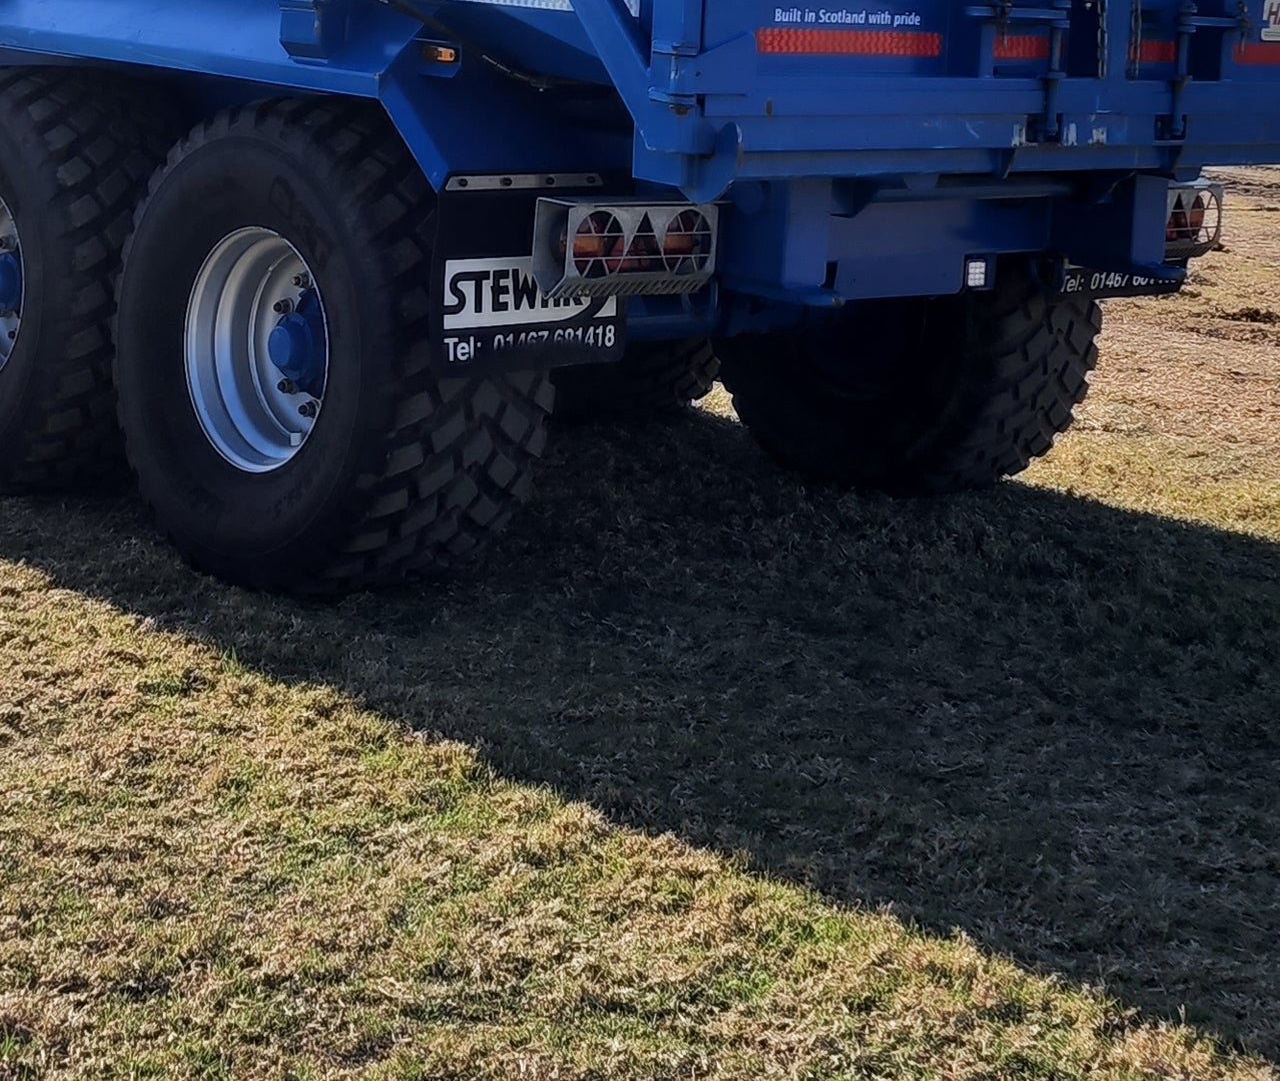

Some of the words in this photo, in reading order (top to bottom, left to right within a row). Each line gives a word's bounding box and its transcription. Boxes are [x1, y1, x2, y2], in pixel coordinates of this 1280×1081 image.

[774, 8, 802, 23] Built
[804, 8, 816, 23] in
[818, 9, 865, 25] Scotland
[868, 10, 892, 25] with
[893, 12, 921, 28] pride
